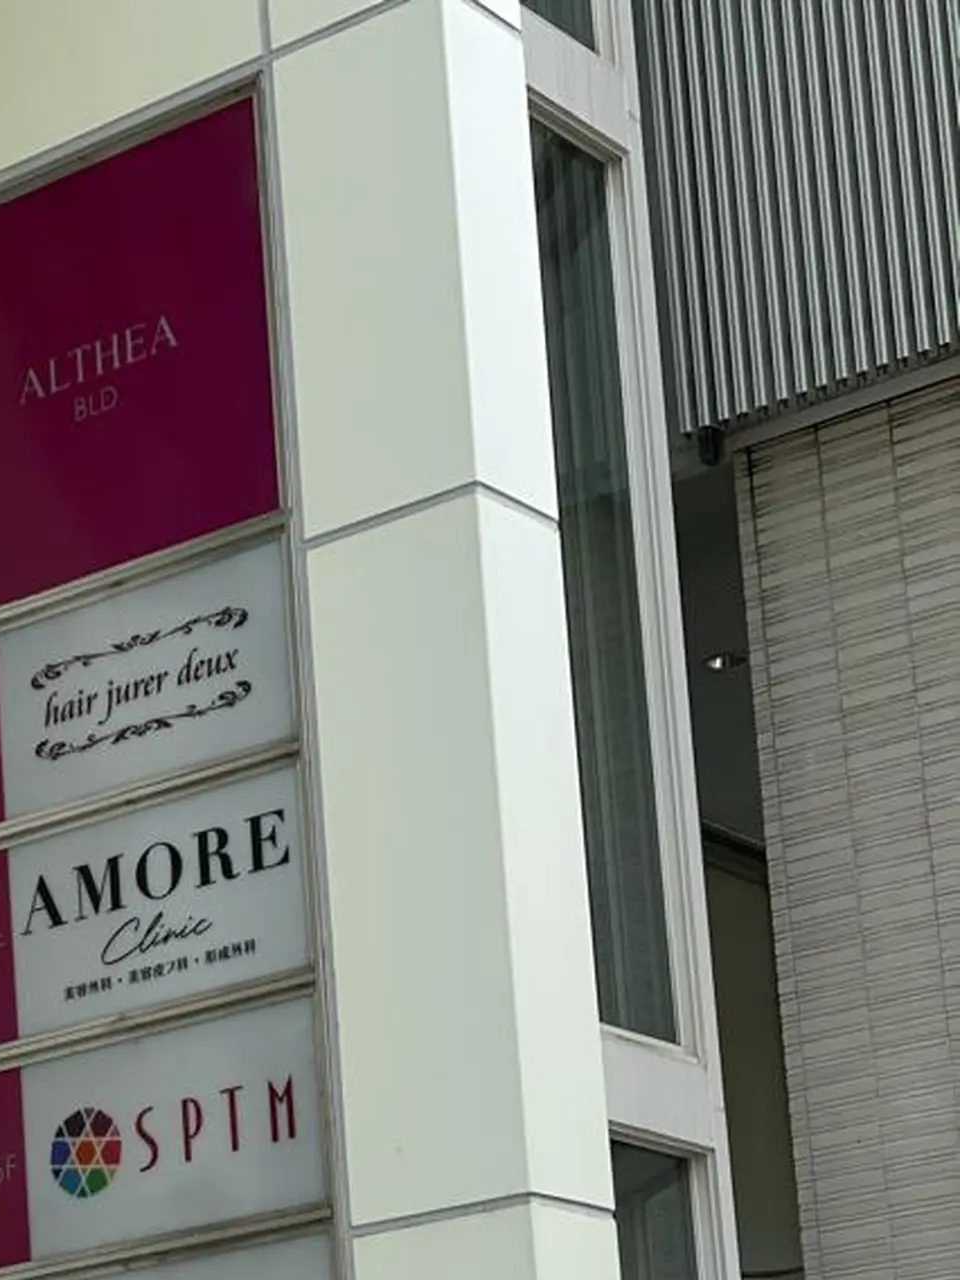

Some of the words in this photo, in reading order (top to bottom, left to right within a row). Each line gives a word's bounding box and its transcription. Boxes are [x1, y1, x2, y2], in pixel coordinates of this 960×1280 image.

[18, 314, 180, 405] ALTHEA
[72, 385, 120, 422] BLD
[43, 690, 98, 728] hair
[98, 670, 169, 725] jurer
[177, 645, 240, 687] deux
[19, 808, 291, 938] AMORE
[100, 911, 214, 966] Clinic
[134, 1073, 298, 1173] SPTM
